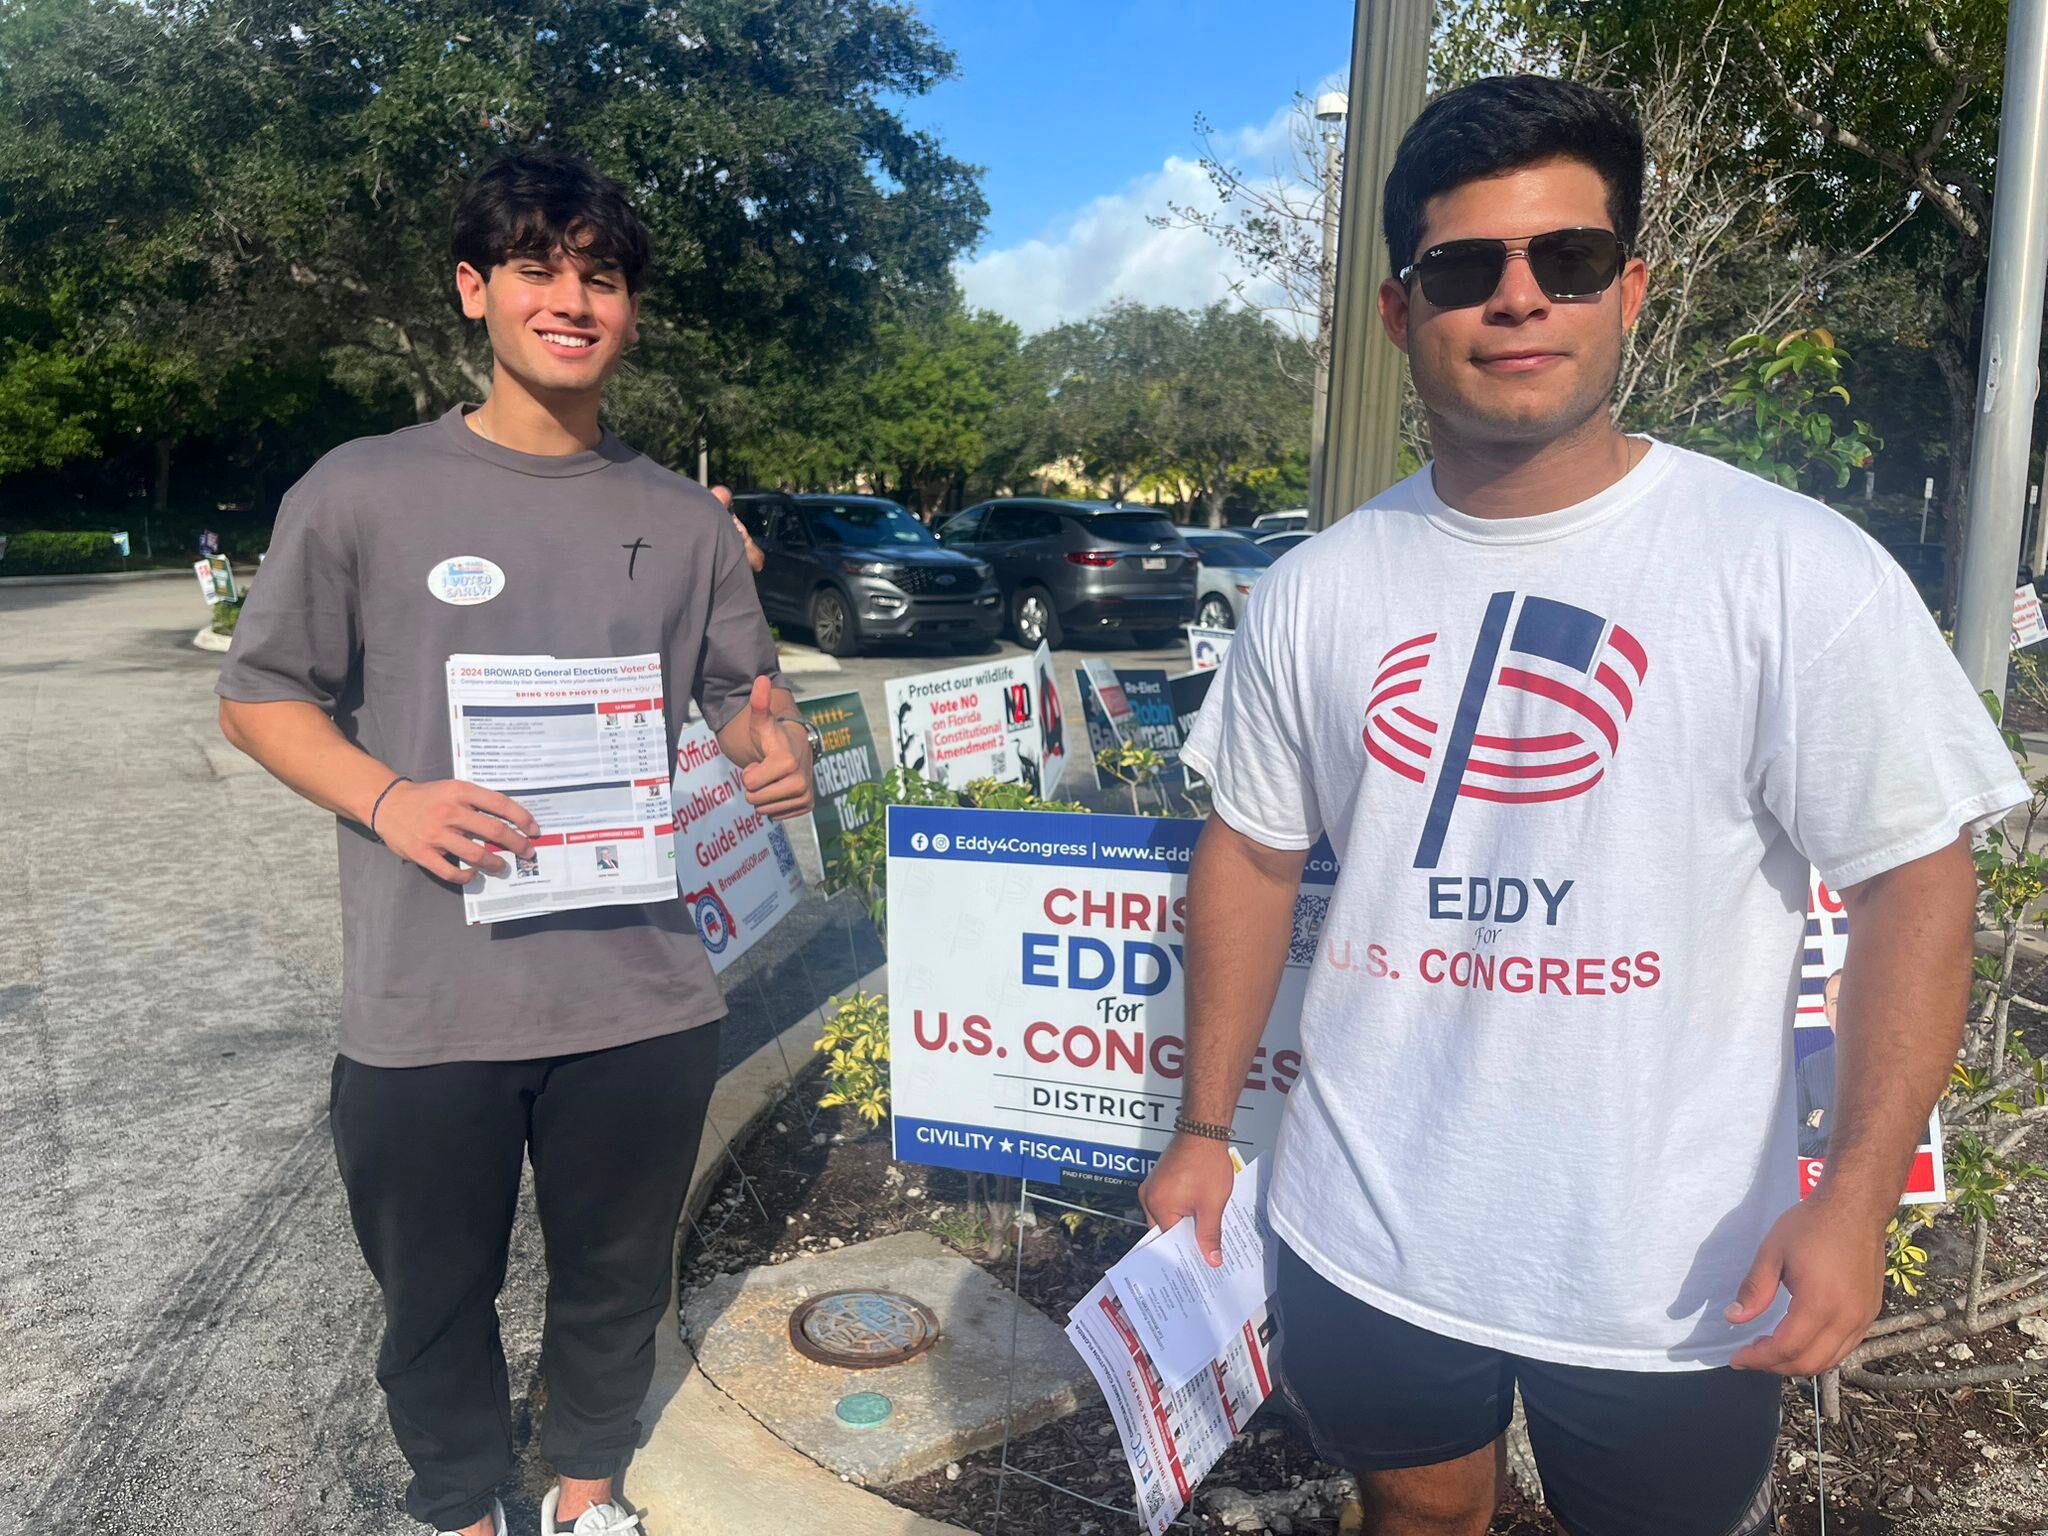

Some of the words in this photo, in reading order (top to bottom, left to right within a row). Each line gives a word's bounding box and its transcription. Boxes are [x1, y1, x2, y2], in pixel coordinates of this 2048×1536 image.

[449, 575, 492, 587] VOTED
[460, 668, 482, 677] 2024
[484, 668, 532, 677] BROWARD
[534, 668, 571, 677] General
[574, 667, 618, 676] Elections
[620, 665, 646, 674] Voter
[908, 679, 952, 698] Protect
[954, 676, 973, 689] our
[976, 666, 1014, 685] wildlife
[930, 699, 958, 715] Vote
[960, 693, 978, 709] NO
[1124, 682, 1161, 694] Re-Elect
[932, 719, 946, 731] on
[949, 711, 982, 728] Florida
[934, 720, 1002, 746] Constitutional
[678, 735, 720, 773] Officia
[822, 727, 852, 752] HERIFF
[936, 739, 997, 761] Amendment
[999, 736, 1005, 747] 2
[814, 745, 872, 797] GREGORY
[672, 779, 735, 835] epublican
[696, 827, 737, 867] Guide
[734, 813, 764, 841] Here
[955, 836, 1087, 857] Eddy4Congress
[718, 847, 770, 892] BrowardGOP.com
[1043, 887, 1187, 934] CHRIS
[1428, 876, 1576, 926] EDDY
[1327, 939, 1400, 979] U.S.
[1418, 948, 1662, 996] CONGRESS
[1096, 995, 1145, 1024] For
[913, 1009, 1007, 1058] U.S.
[1033, 1087, 1165, 1122] DISTRICT
[916, 1126, 994, 1150] CIVILITY
[1019, 1140, 1087, 1165] FISCAL
[1092, 1151, 1157, 1175] DISCIP
[1062, 1170, 1077, 1178] PAID
[1078, 1172, 1093, 1180] FOR
[1094, 1174, 1103, 1182] BY
[1104, 1176, 1123, 1185] EDDY
[1074, 1323, 1094, 1350] FLORIDA
[1092, 1349, 1114, 1384] COALITION
[1129, 1432, 1147, 1469] CFC
